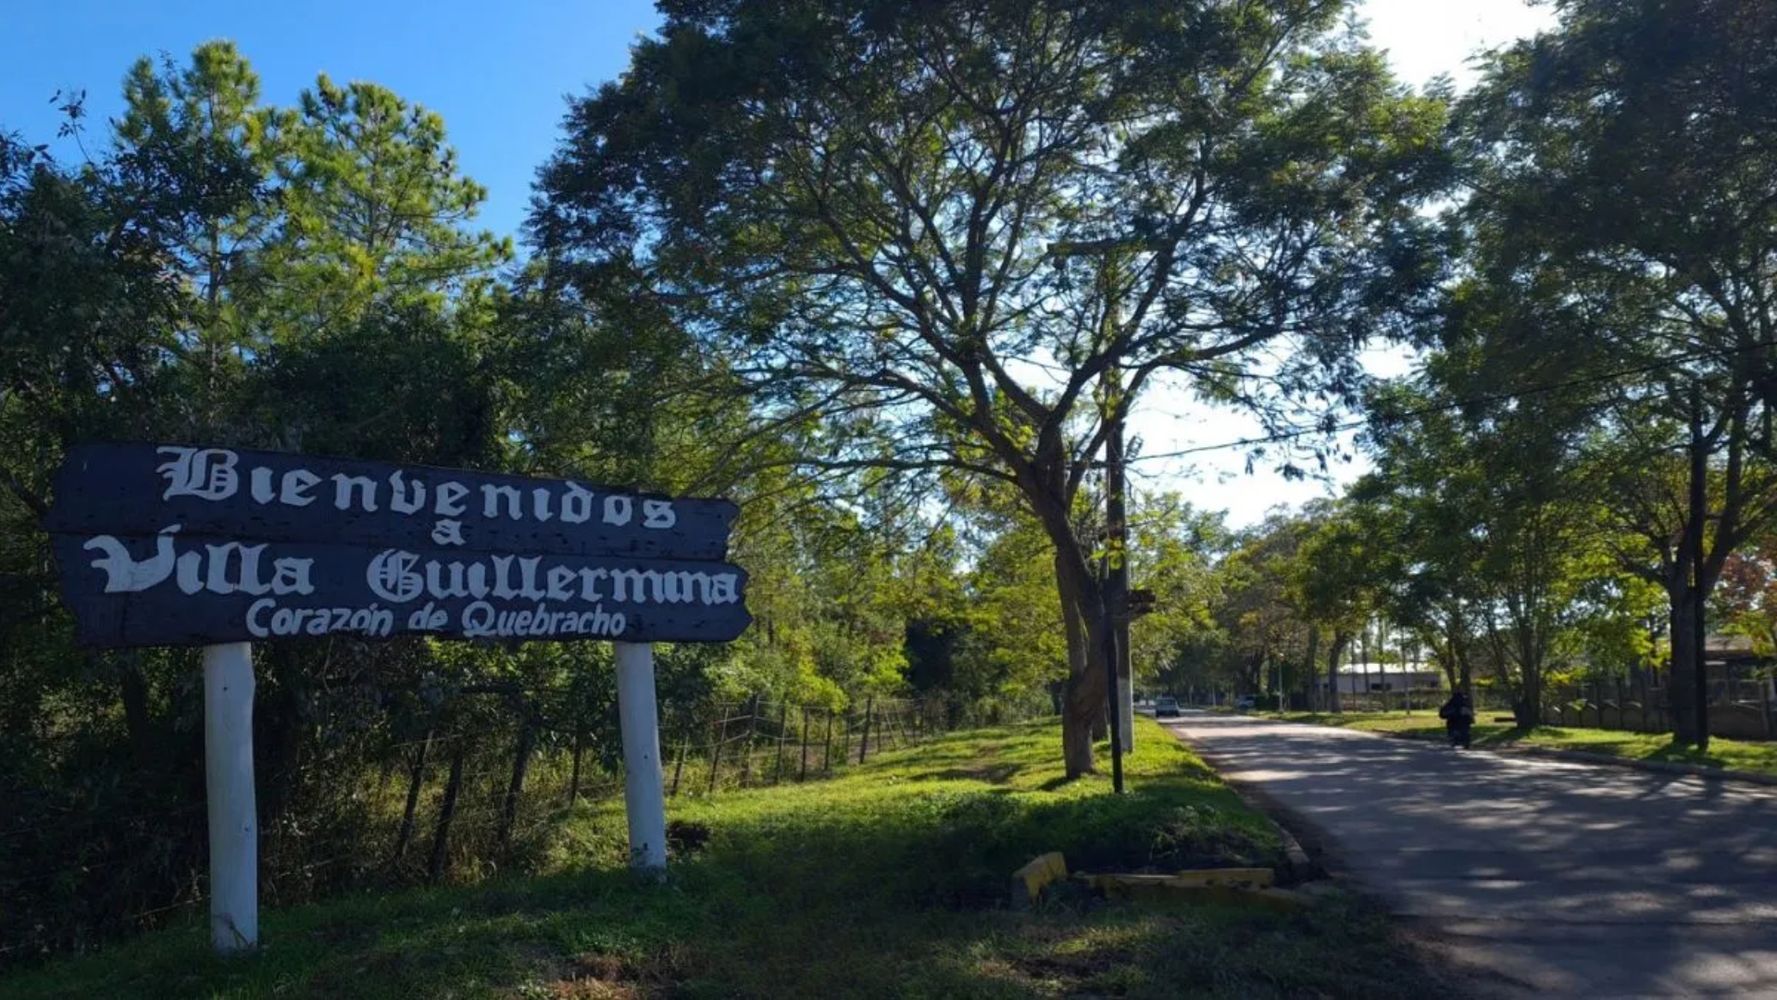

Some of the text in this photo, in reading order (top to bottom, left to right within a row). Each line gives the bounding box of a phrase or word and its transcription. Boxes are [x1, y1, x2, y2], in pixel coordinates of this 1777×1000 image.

[156, 446, 677, 529] Bienvenidos
[431, 518, 466, 545] a
[83, 523, 739, 605] Villa Guillermina
[246, 598, 626, 638] Corazón de Quebracho
